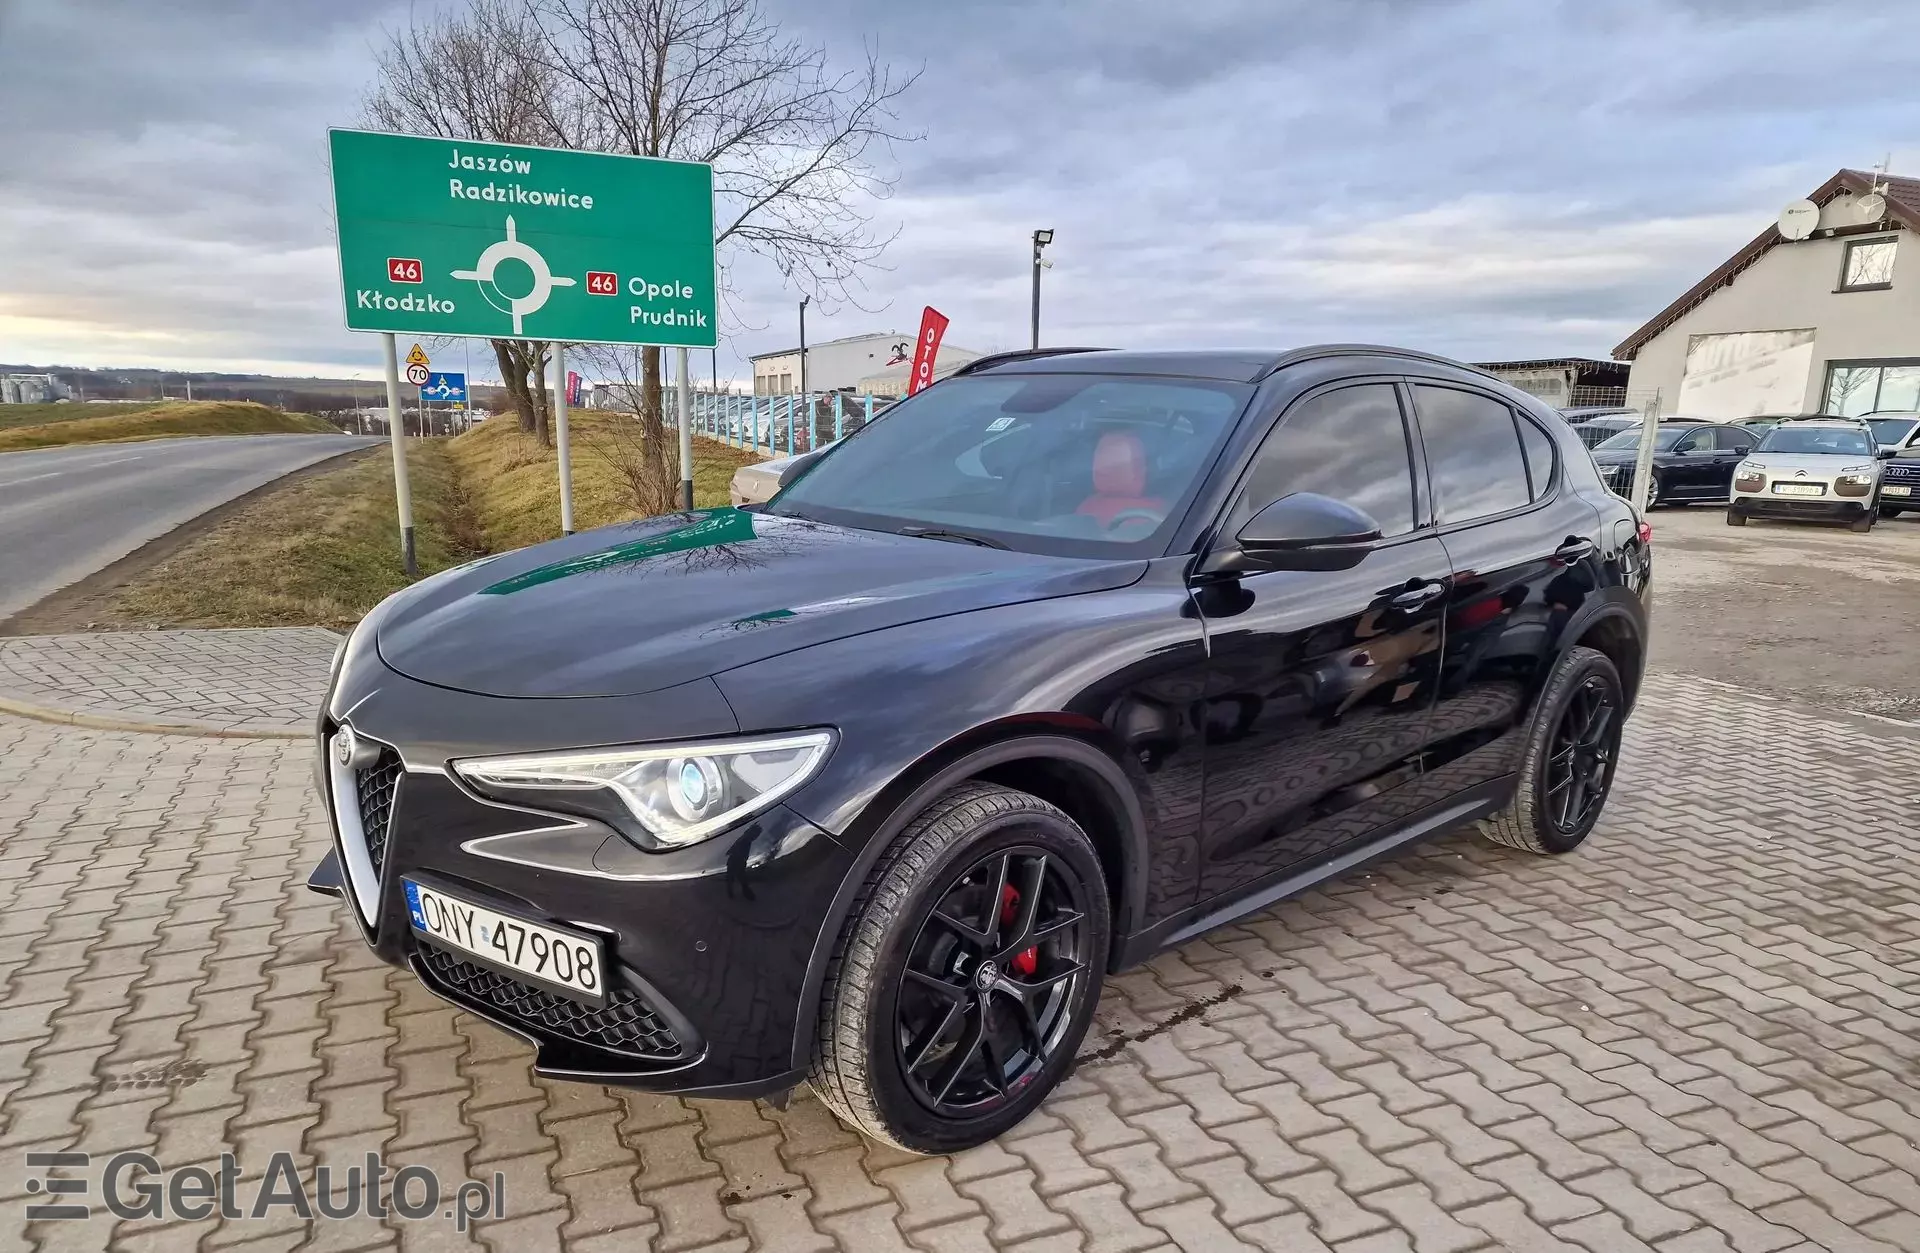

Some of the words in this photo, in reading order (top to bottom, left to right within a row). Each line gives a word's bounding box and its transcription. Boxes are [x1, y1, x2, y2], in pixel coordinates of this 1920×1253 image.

[449, 149, 531, 175] Jaszów
[449, 178, 594, 210] Radzikowice
[393, 262, 418, 280] 46
[591, 276, 613, 292] 46
[628, 277, 693, 302] Opole
[356, 289, 456, 314] Kłodzko
[630, 306, 707, 328] Prudnik
[411, 369, 427, 380] 70
[412, 910, 425, 925] PL
[422, 892, 474, 949] ONY
[491, 920, 597, 990] 47908
